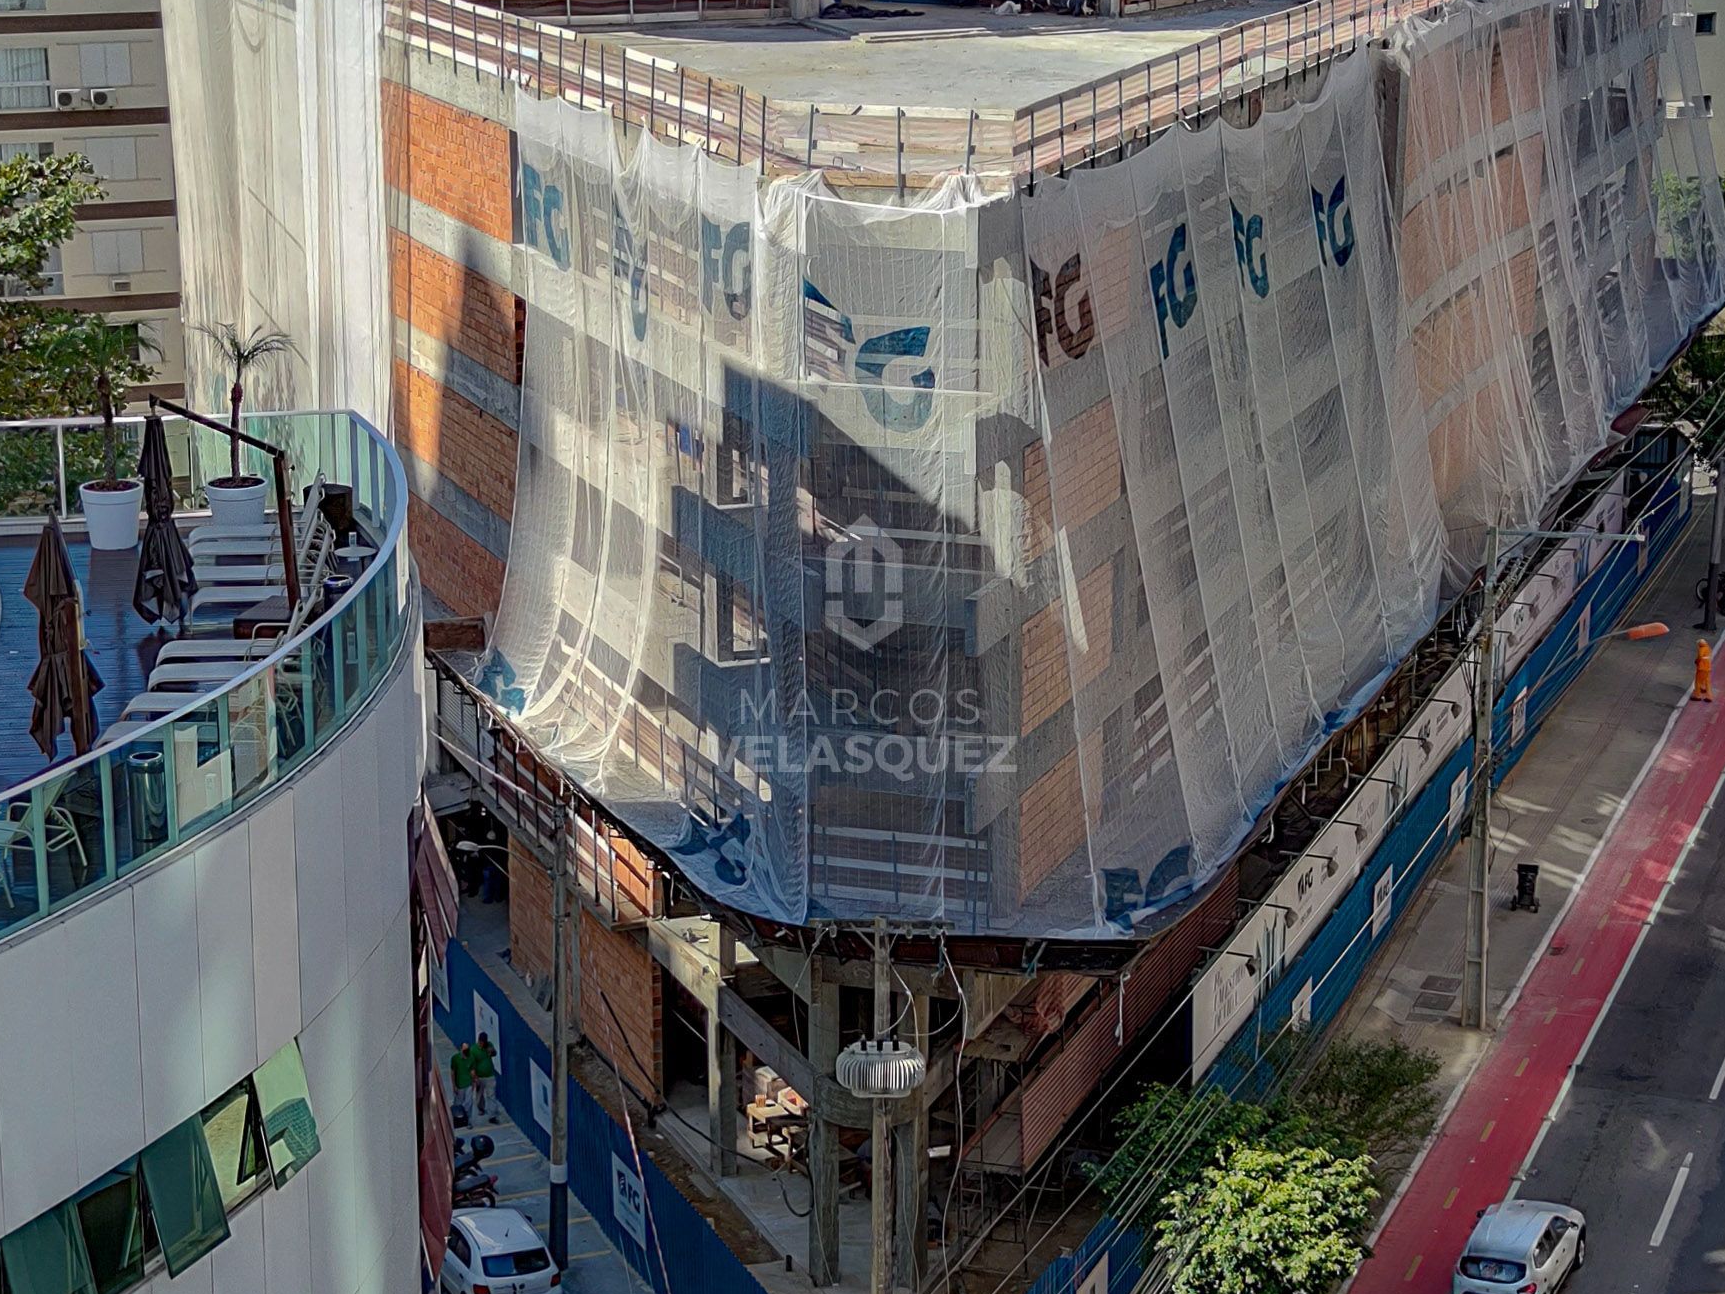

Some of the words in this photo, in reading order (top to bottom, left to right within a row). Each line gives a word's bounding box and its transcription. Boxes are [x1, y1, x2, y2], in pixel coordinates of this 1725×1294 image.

[524, 163, 570, 272] FG
[701, 213, 752, 321] FG
[1229, 197, 1269, 299] FG
[1311, 175, 1355, 267] FG
[1029, 253, 1096, 367] FG
[1149, 223, 1198, 360] FG
[628, 1182, 641, 1215] FG
